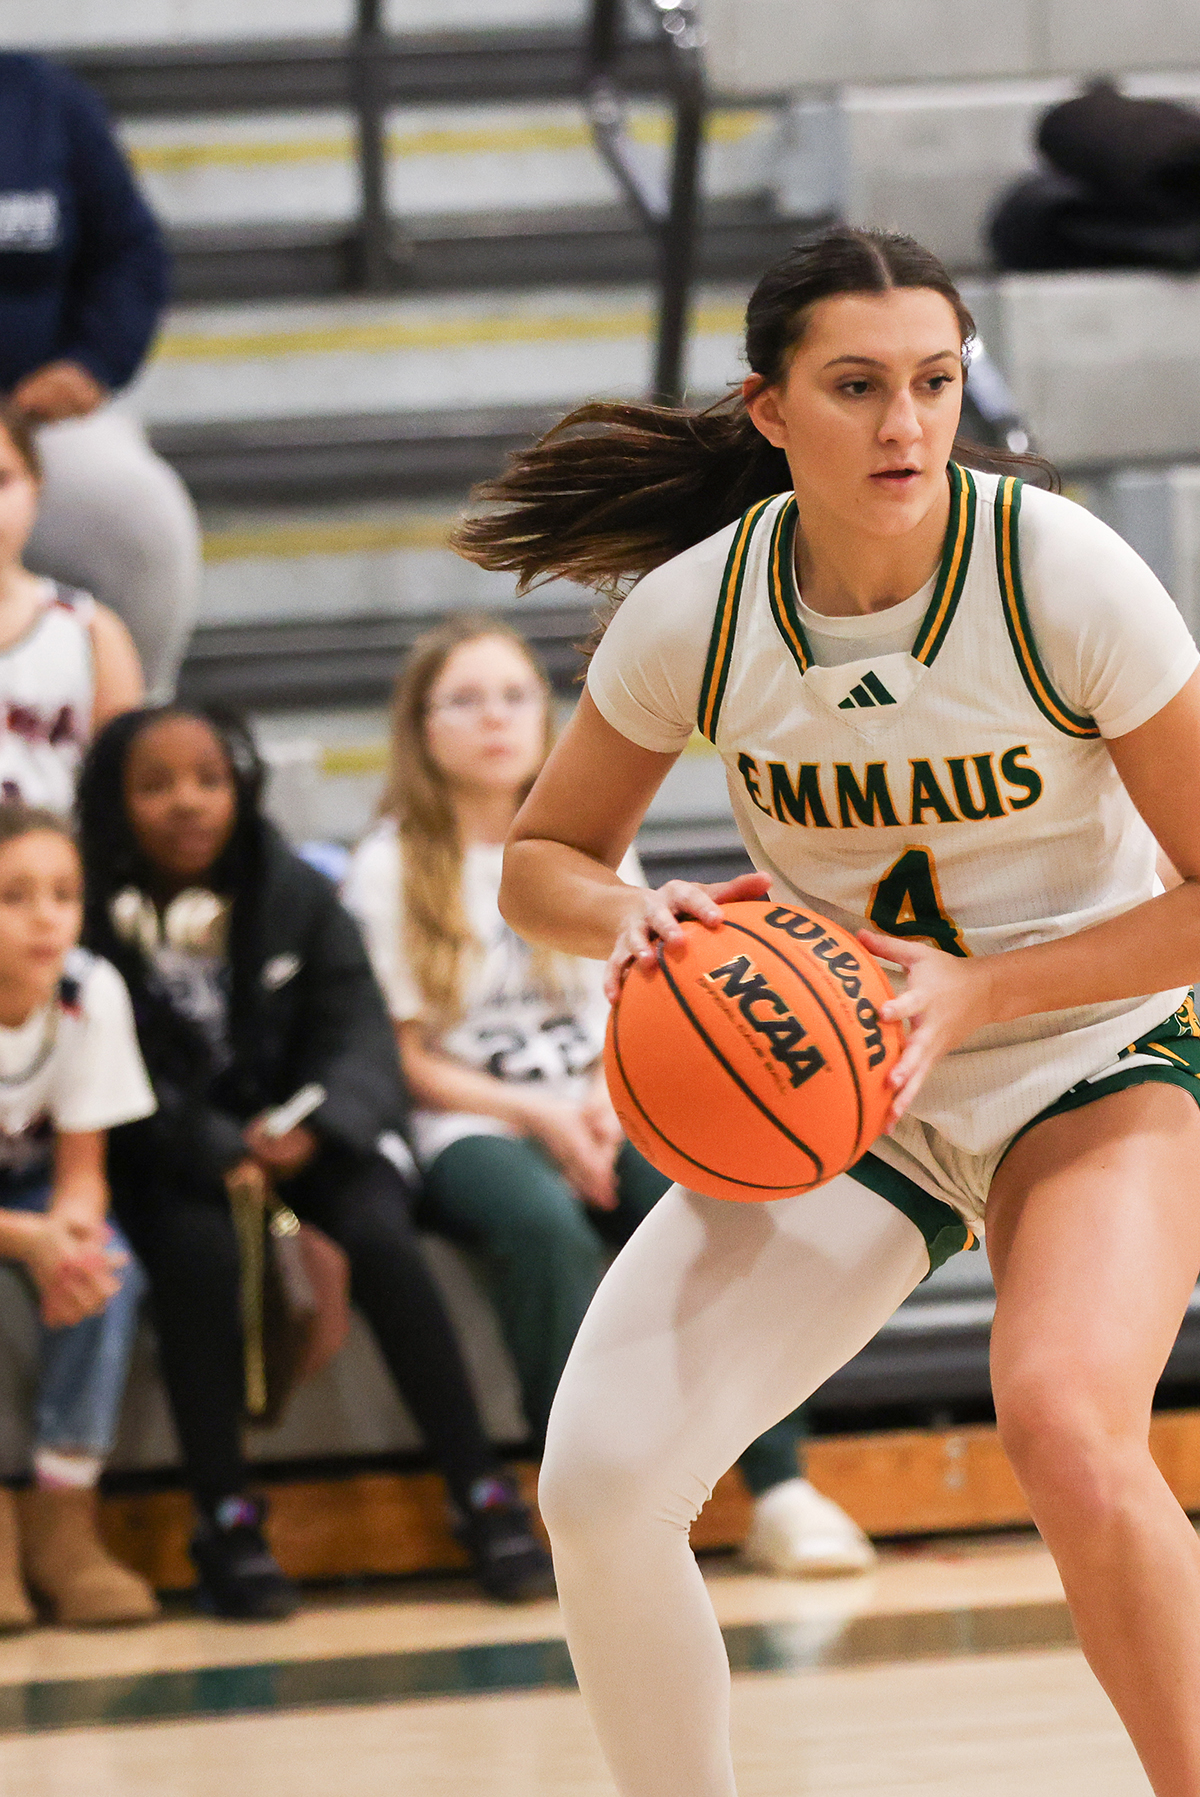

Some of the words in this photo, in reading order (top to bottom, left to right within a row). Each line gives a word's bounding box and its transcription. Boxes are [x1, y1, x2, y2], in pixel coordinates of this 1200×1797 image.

[737, 744, 1044, 829] EMMAUS
[864, 844, 973, 958] 4
[703, 953, 827, 1090] NCAA
[764, 906, 887, 1071] Wilson
